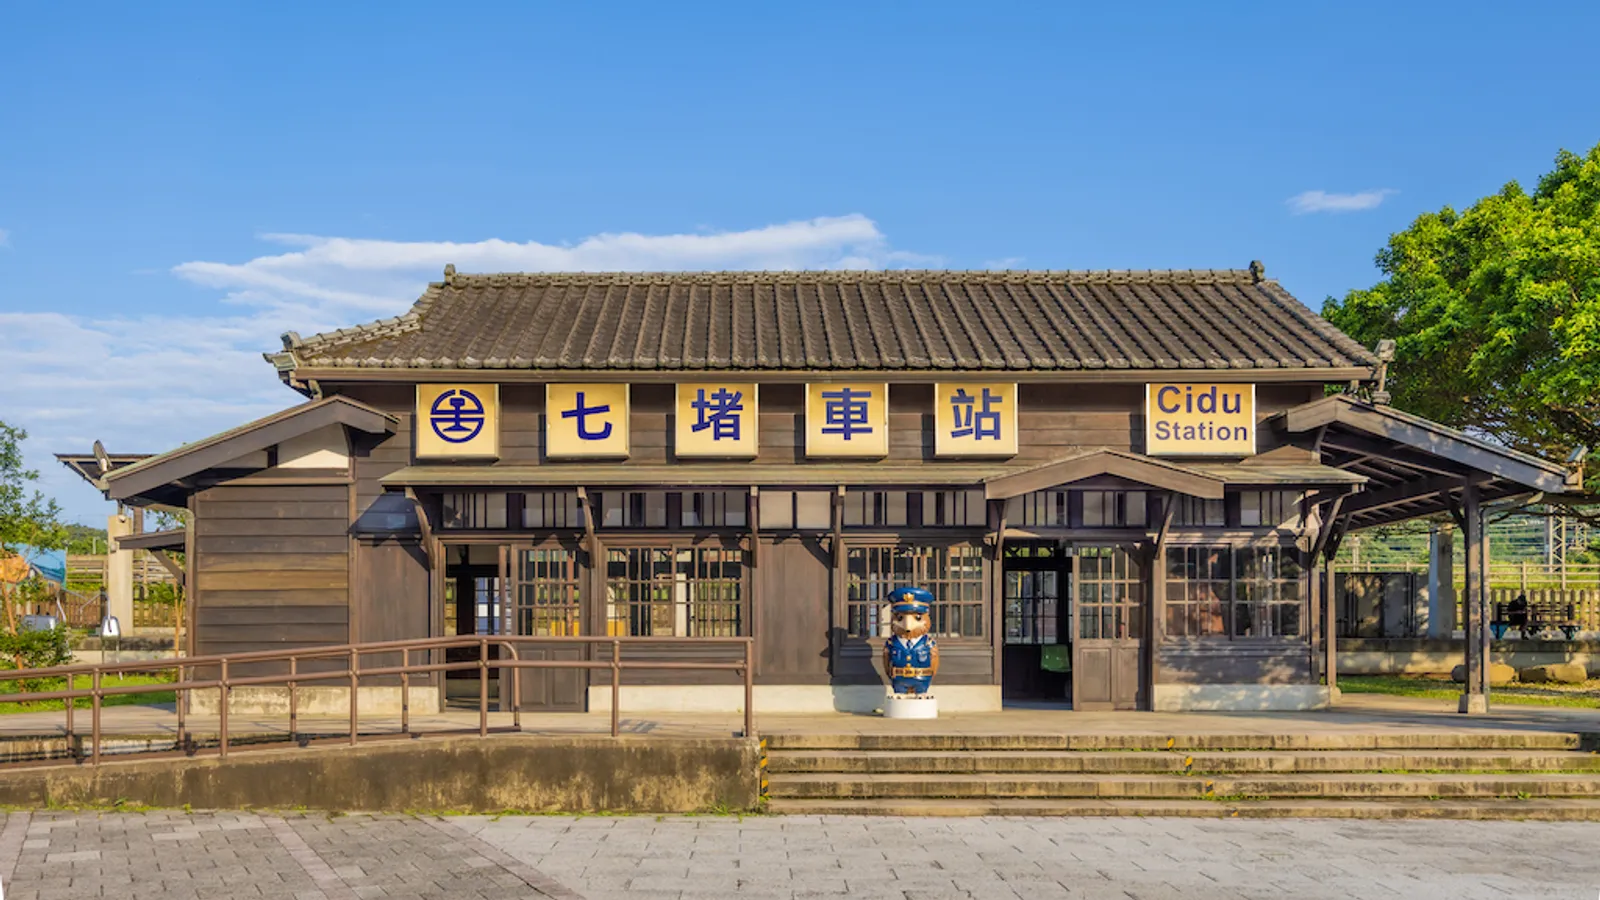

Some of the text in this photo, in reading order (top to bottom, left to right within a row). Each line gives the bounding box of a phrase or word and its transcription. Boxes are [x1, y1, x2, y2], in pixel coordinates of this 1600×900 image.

[1157, 385, 1241, 414] Cidu
[561, 388, 1003, 441] 七堵車站
[1155, 420, 1248, 441] Station
